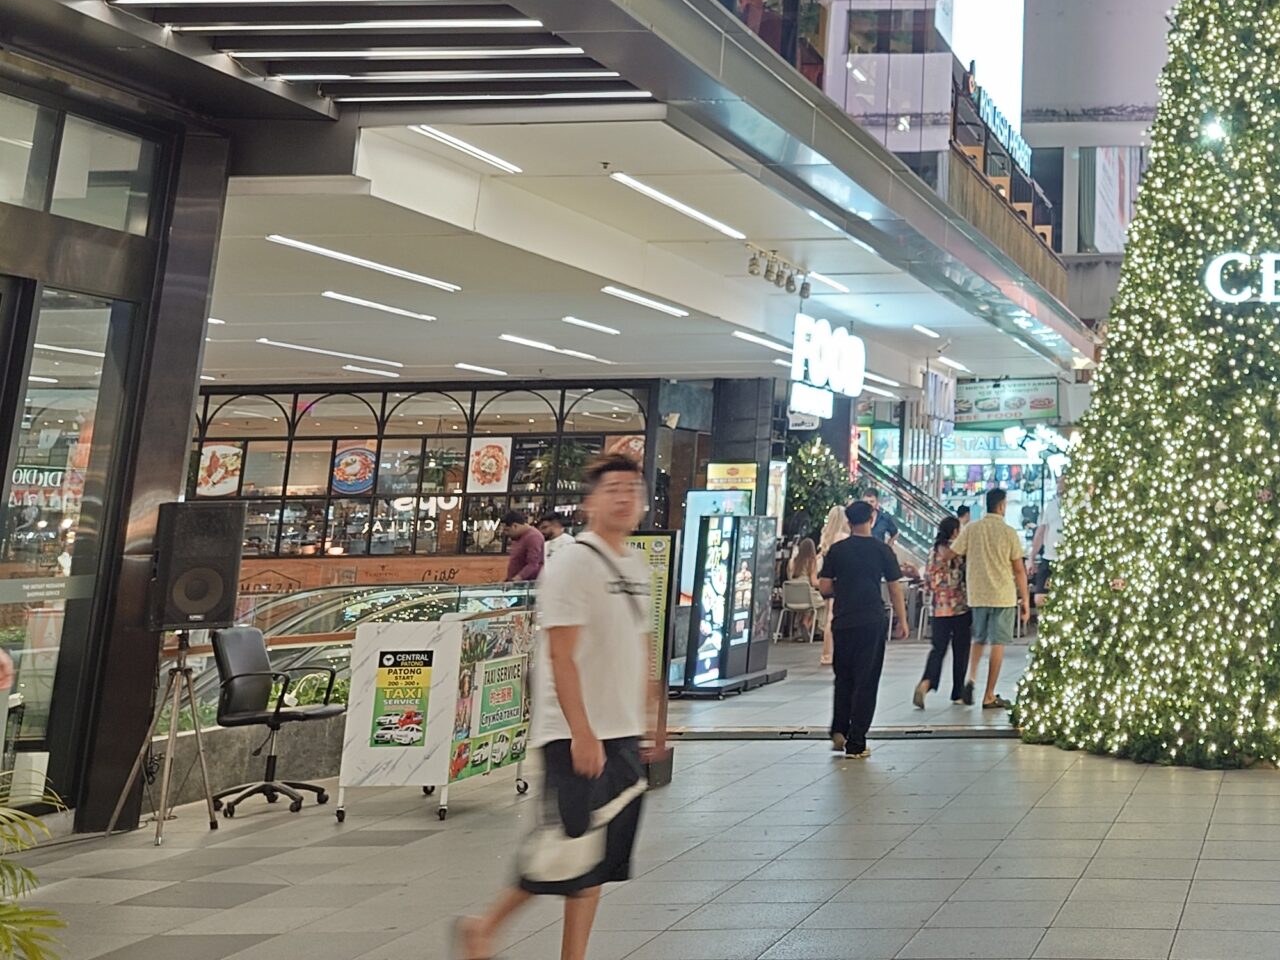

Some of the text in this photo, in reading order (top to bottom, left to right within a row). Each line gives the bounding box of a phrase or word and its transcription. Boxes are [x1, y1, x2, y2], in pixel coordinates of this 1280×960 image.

[791, 313, 866, 397] FOOD
[987, 411, 1023, 419] FOOD
[421, 567, 460, 582] Ciao
[396, 653, 429, 662] CENTRAL
[484, 664, 521, 686] TAXI SERVICE
[383, 688, 423, 699] TAXI
